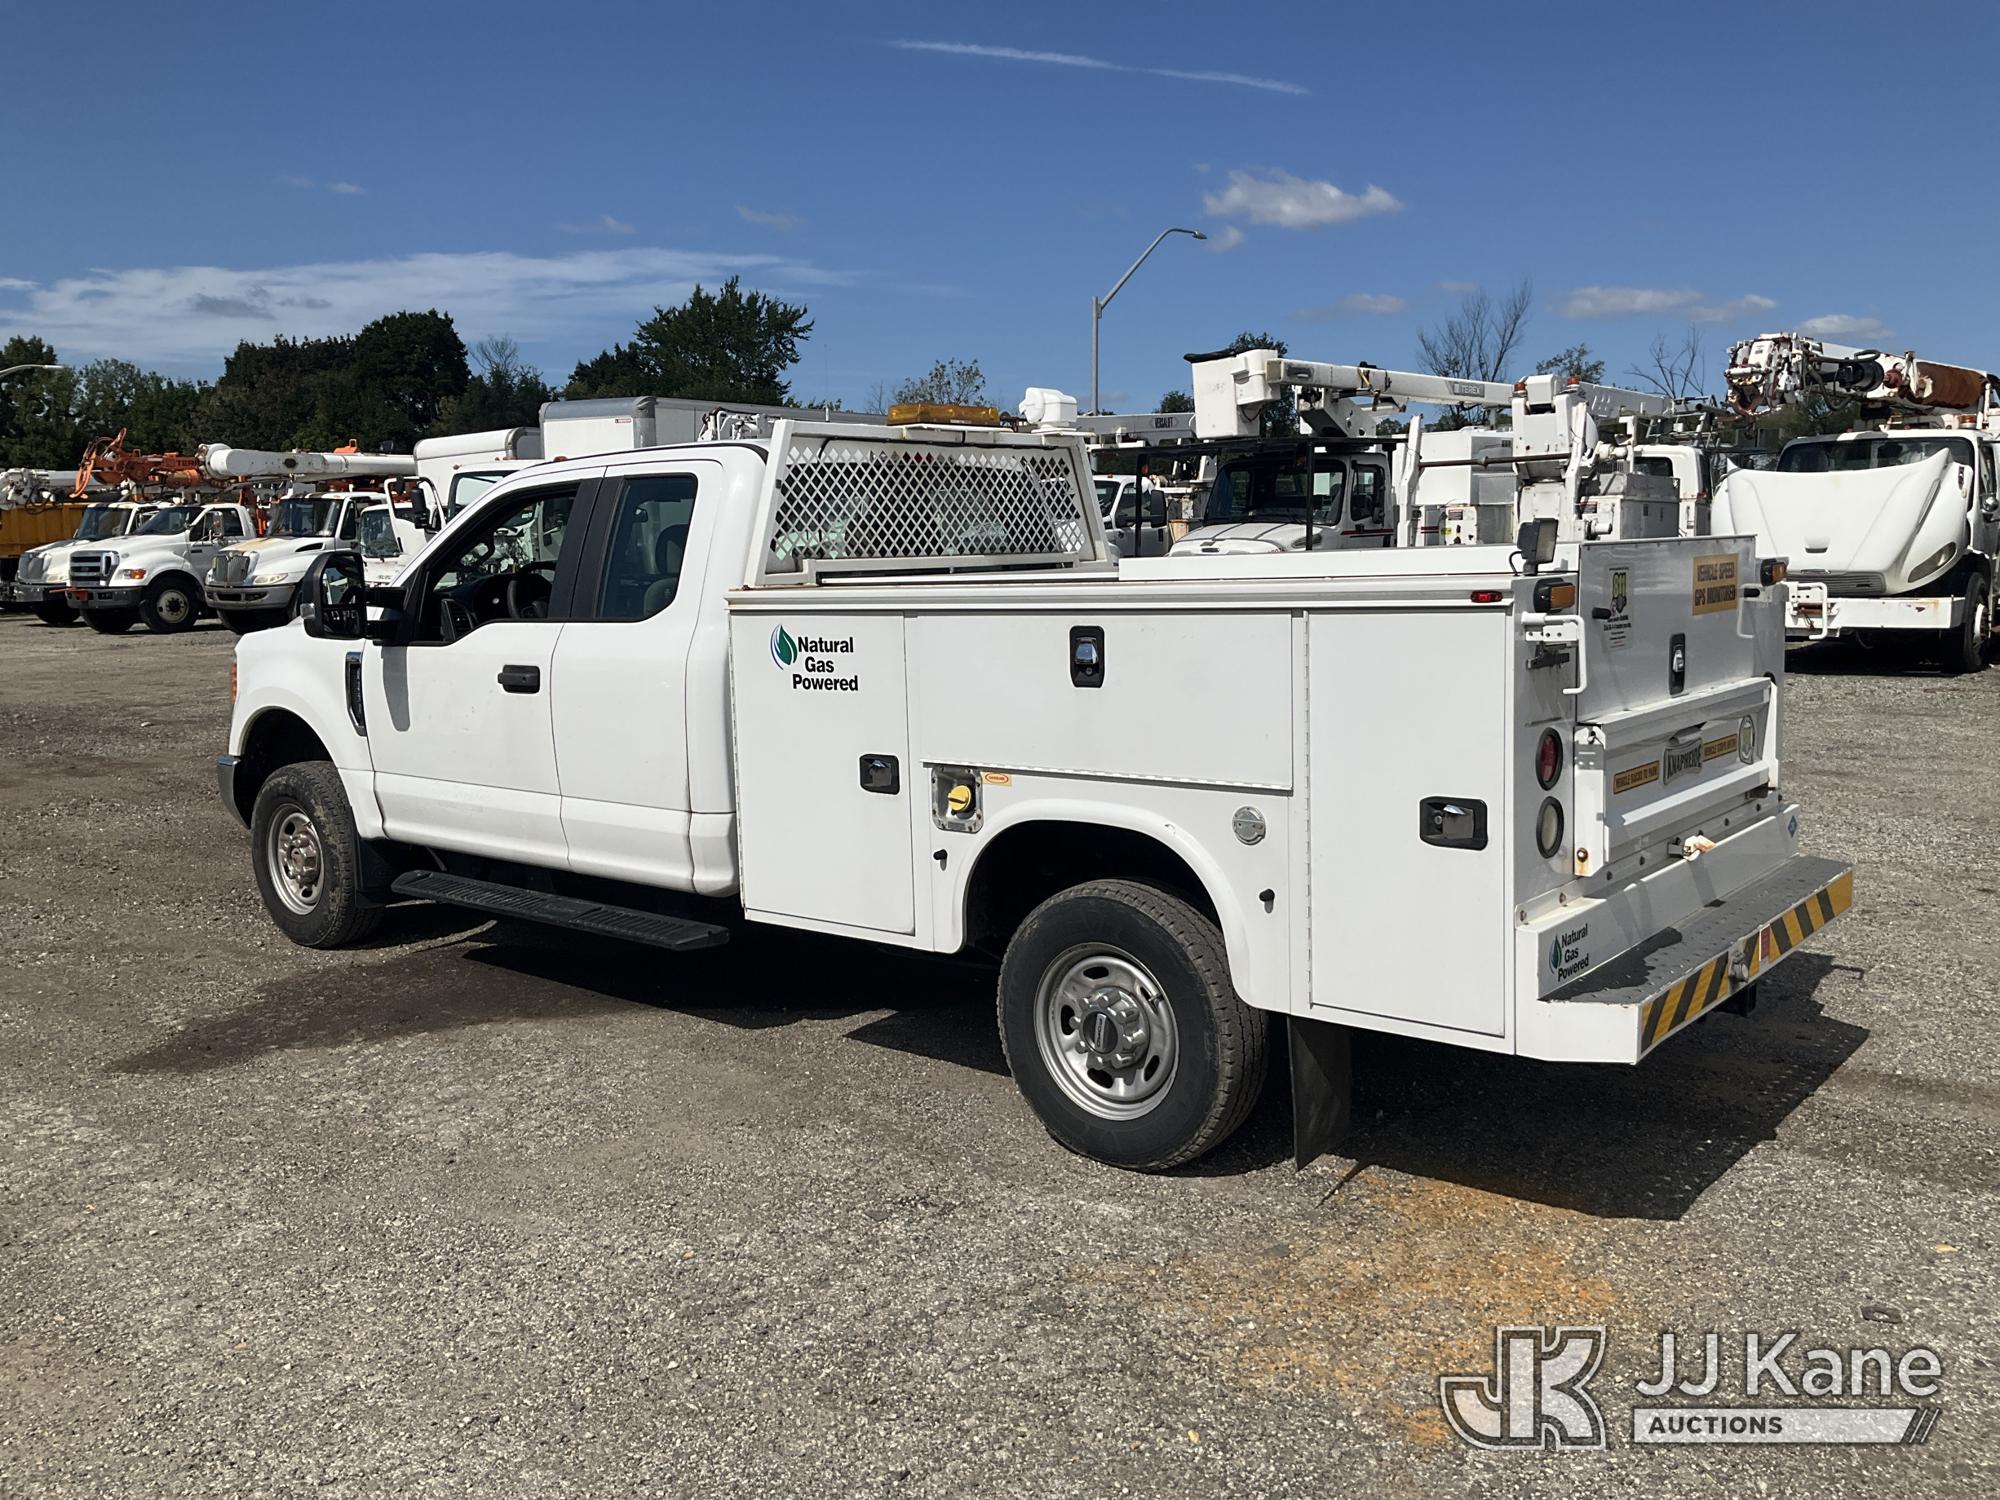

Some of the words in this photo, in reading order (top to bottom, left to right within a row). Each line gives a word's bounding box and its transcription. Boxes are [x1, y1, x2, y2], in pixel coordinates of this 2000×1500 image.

[1461, 384, 1481, 395] TEREX
[1697, 564, 1718, 582] VEHICLE
[1719, 561, 1735, 579] SPEED
[1695, 588, 1706, 607] GPS
[797, 636, 854, 653] Natural
[804, 656, 835, 673] Gas
[792, 673, 859, 691] Powered
[1561, 922, 1588, 948] Natural
[1564, 948, 1579, 963] Gas
[1557, 952, 1589, 982] Powered
